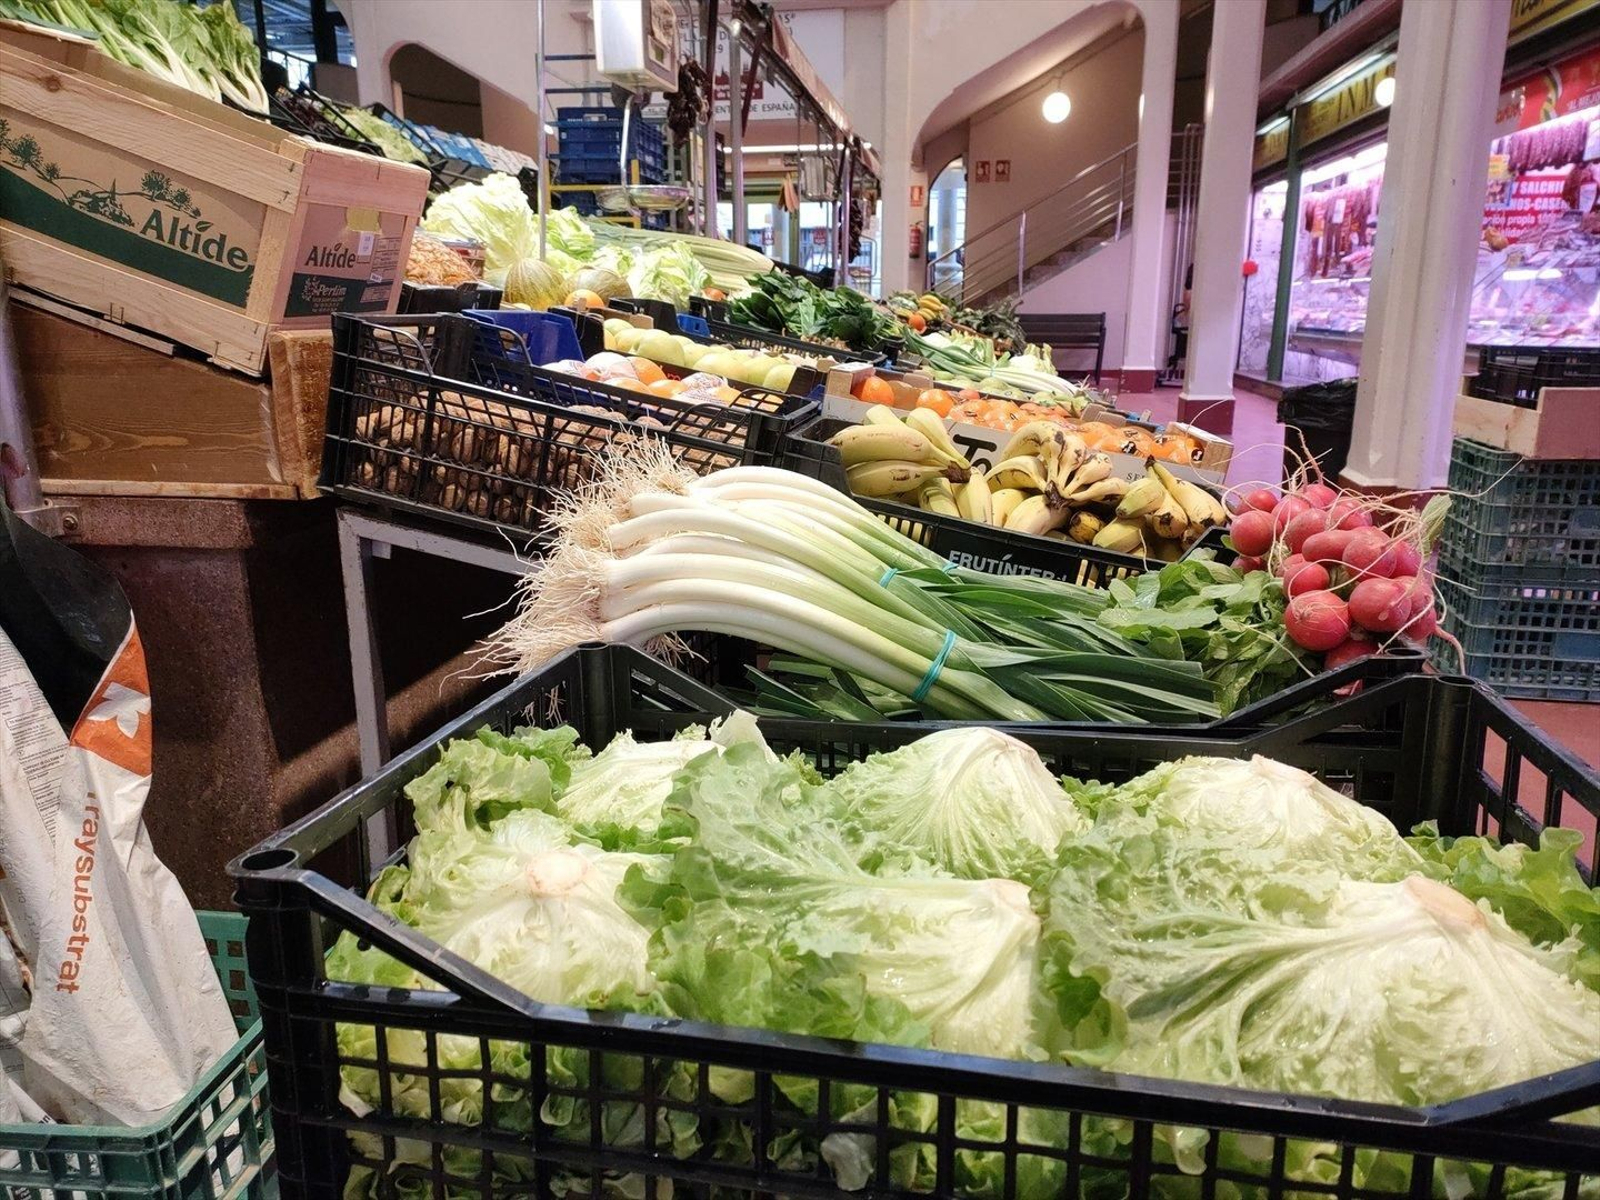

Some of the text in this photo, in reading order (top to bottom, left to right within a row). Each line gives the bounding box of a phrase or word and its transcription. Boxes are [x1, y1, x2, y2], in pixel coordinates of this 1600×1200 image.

[761, 100, 796, 112] ESPAÑA
[141, 208, 250, 272] Altide
[305, 243, 356, 269] Altide
[56, 791, 100, 995] raysubstrat
